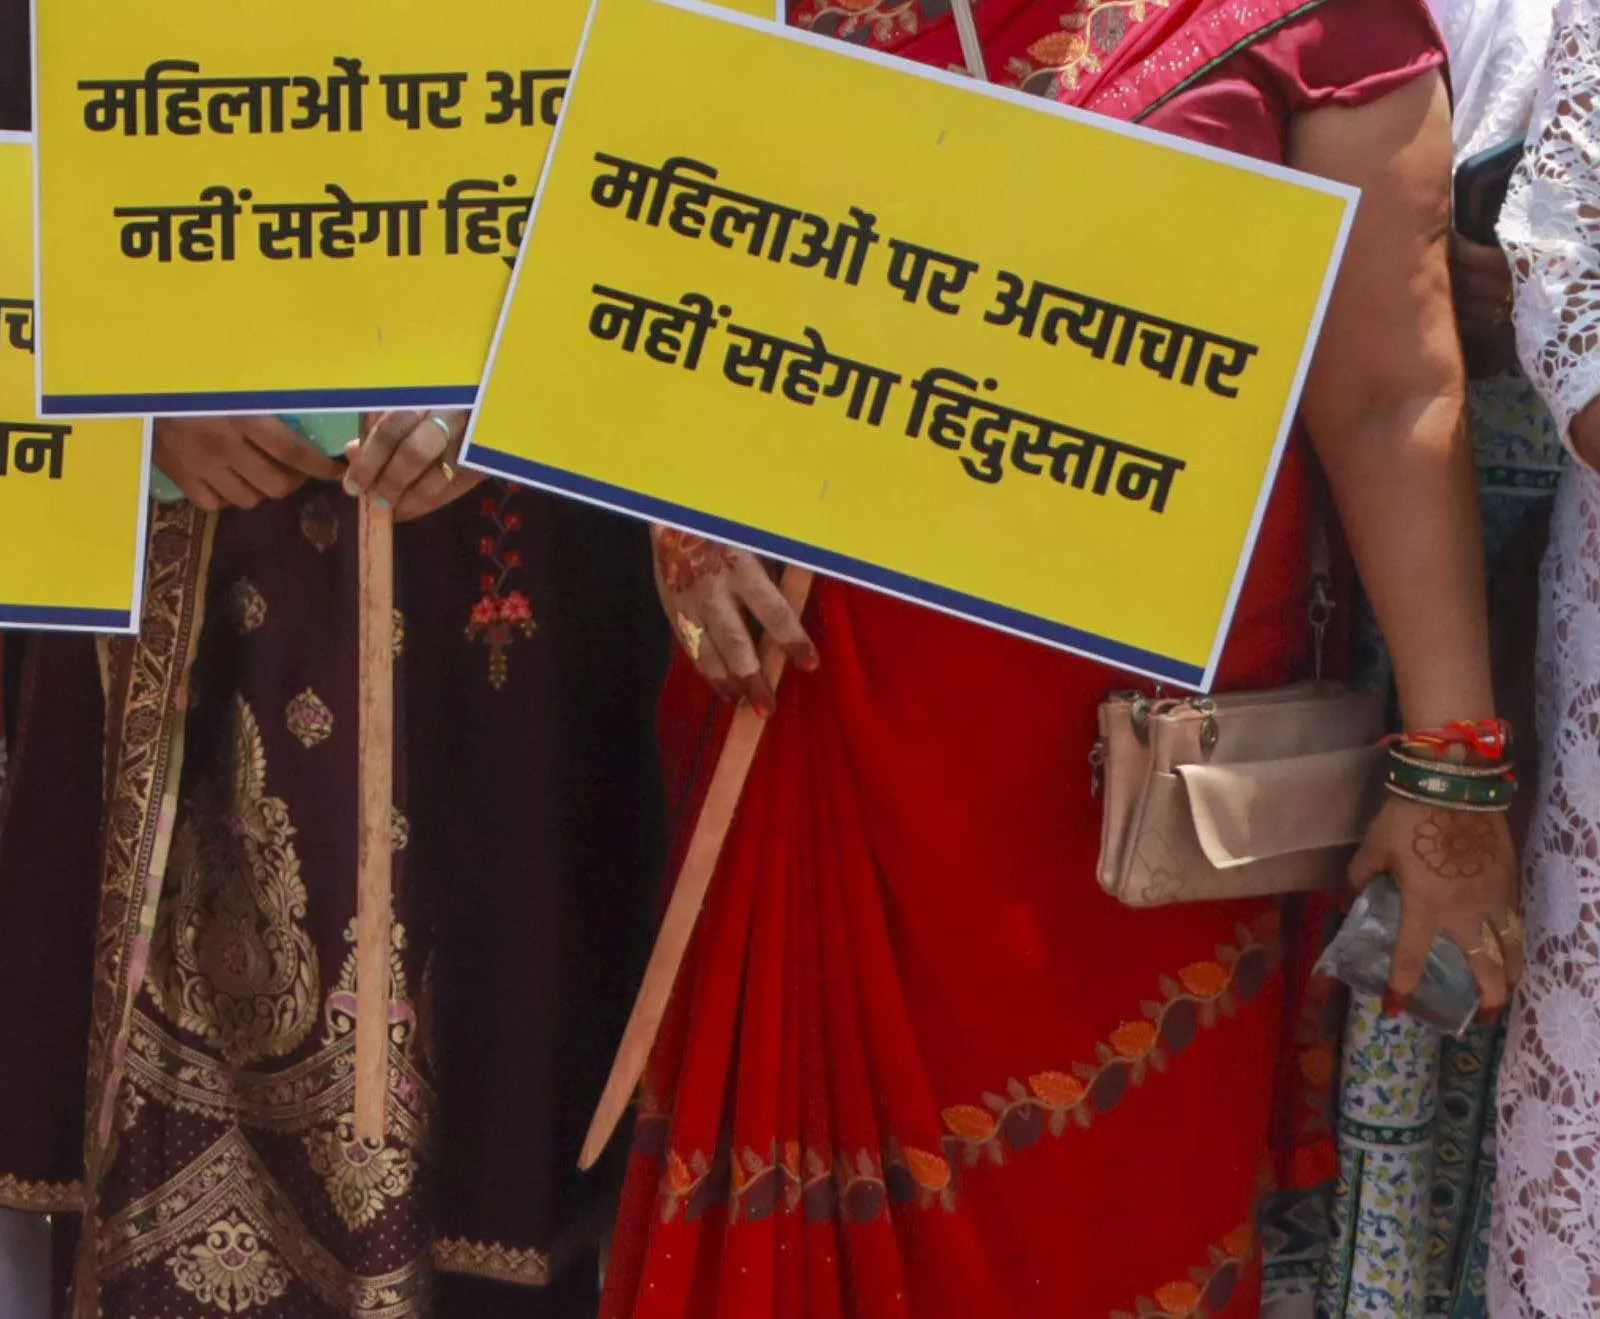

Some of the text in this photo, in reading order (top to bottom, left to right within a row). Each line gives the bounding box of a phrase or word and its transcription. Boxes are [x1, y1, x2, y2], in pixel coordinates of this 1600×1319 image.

[78, 57, 369, 136] महिलाओं
[379, 72, 467, 129] पर
[114, 186, 252, 262] नहीं
[252, 184, 428, 259] सहेगा
[591, 153, 879, 285] महिलाओं
[888, 239, 979, 315] पर
[984, 271, 1258, 398] अत्याचार
[590, 284, 1185, 513] नहीं सहेगा हिंदुस्तान
